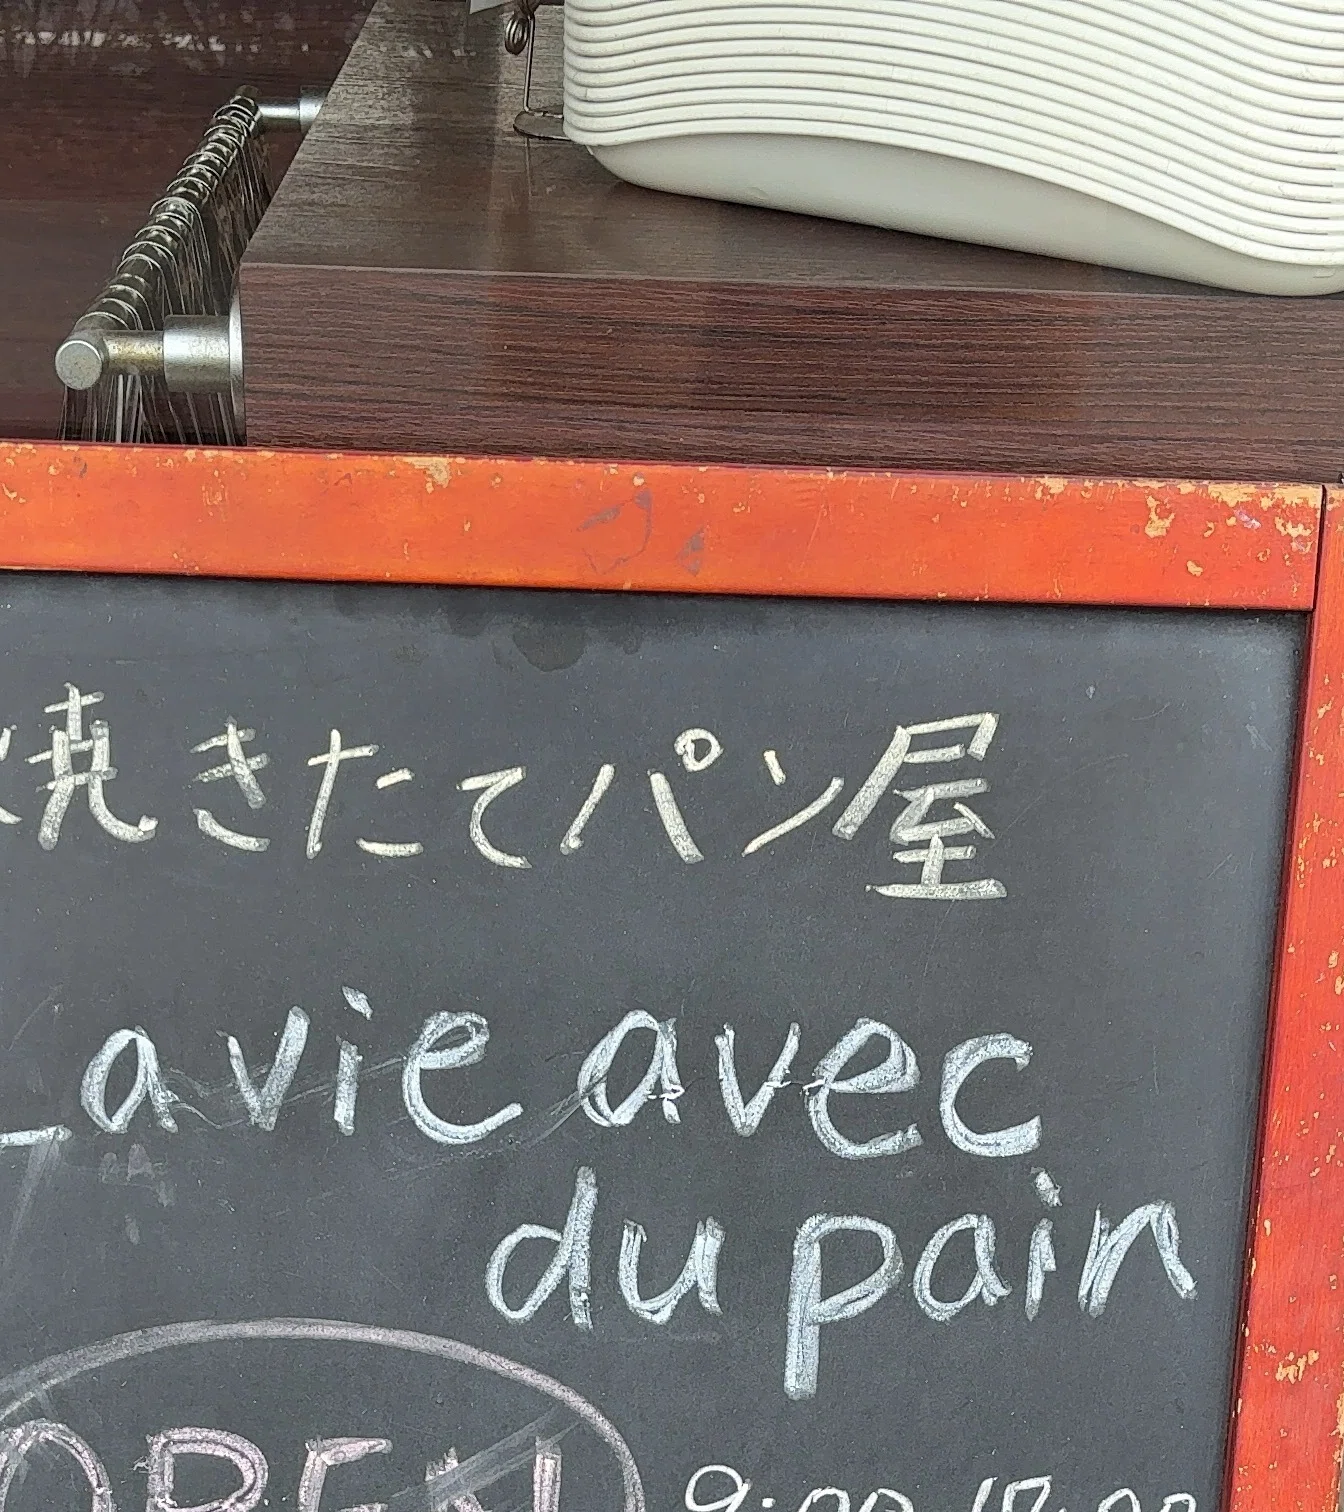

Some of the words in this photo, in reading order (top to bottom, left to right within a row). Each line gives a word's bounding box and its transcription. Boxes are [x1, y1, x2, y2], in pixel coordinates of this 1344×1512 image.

[220, 985, 524, 1146] vie
[576, 1008, 1044, 1158] avec
[484, 1166, 724, 1326] du
[782, 1168, 1198, 1396] pain
